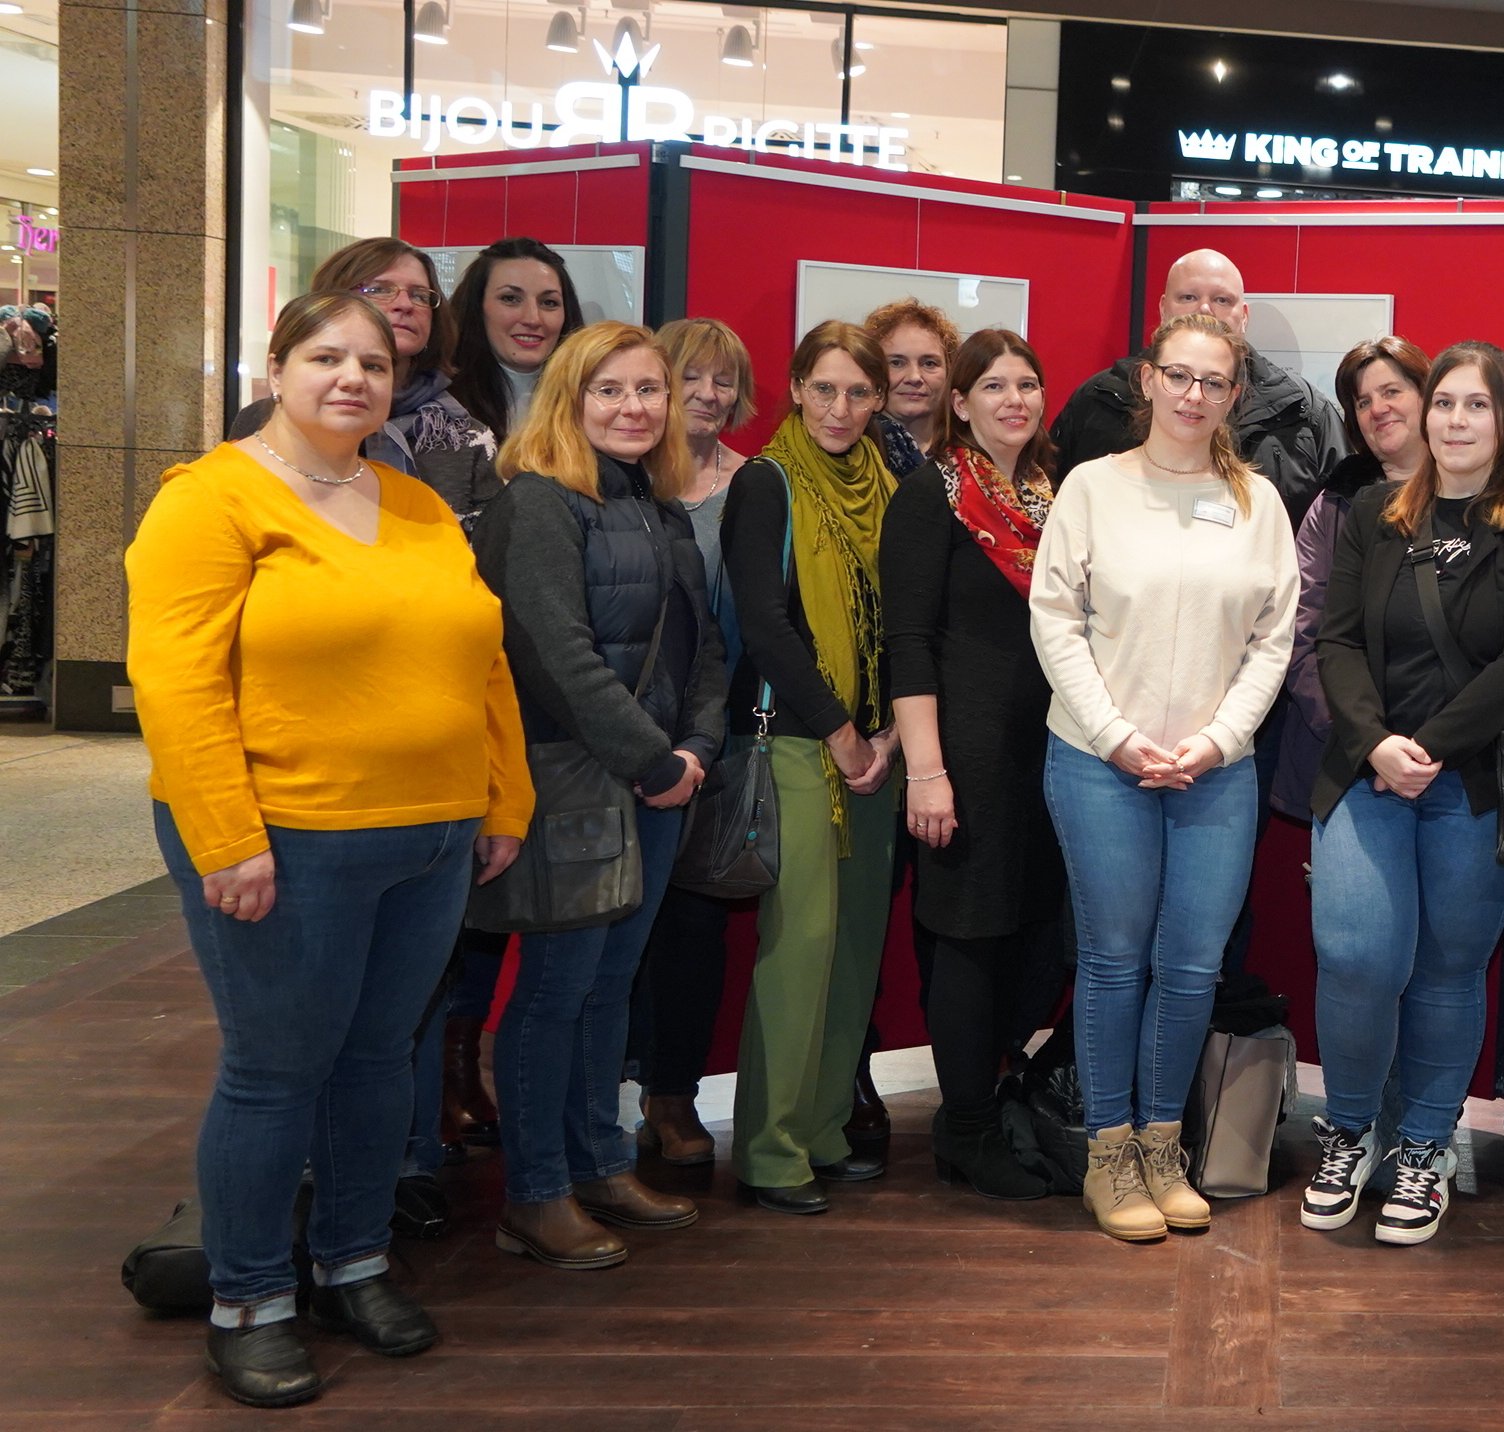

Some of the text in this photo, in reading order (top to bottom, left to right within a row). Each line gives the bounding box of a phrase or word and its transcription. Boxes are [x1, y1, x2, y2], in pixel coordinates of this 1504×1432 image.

[369, 89, 543, 152] BIJOU
[1244, 133, 1339, 168] KING
[1342, 140, 1380, 170] OF
